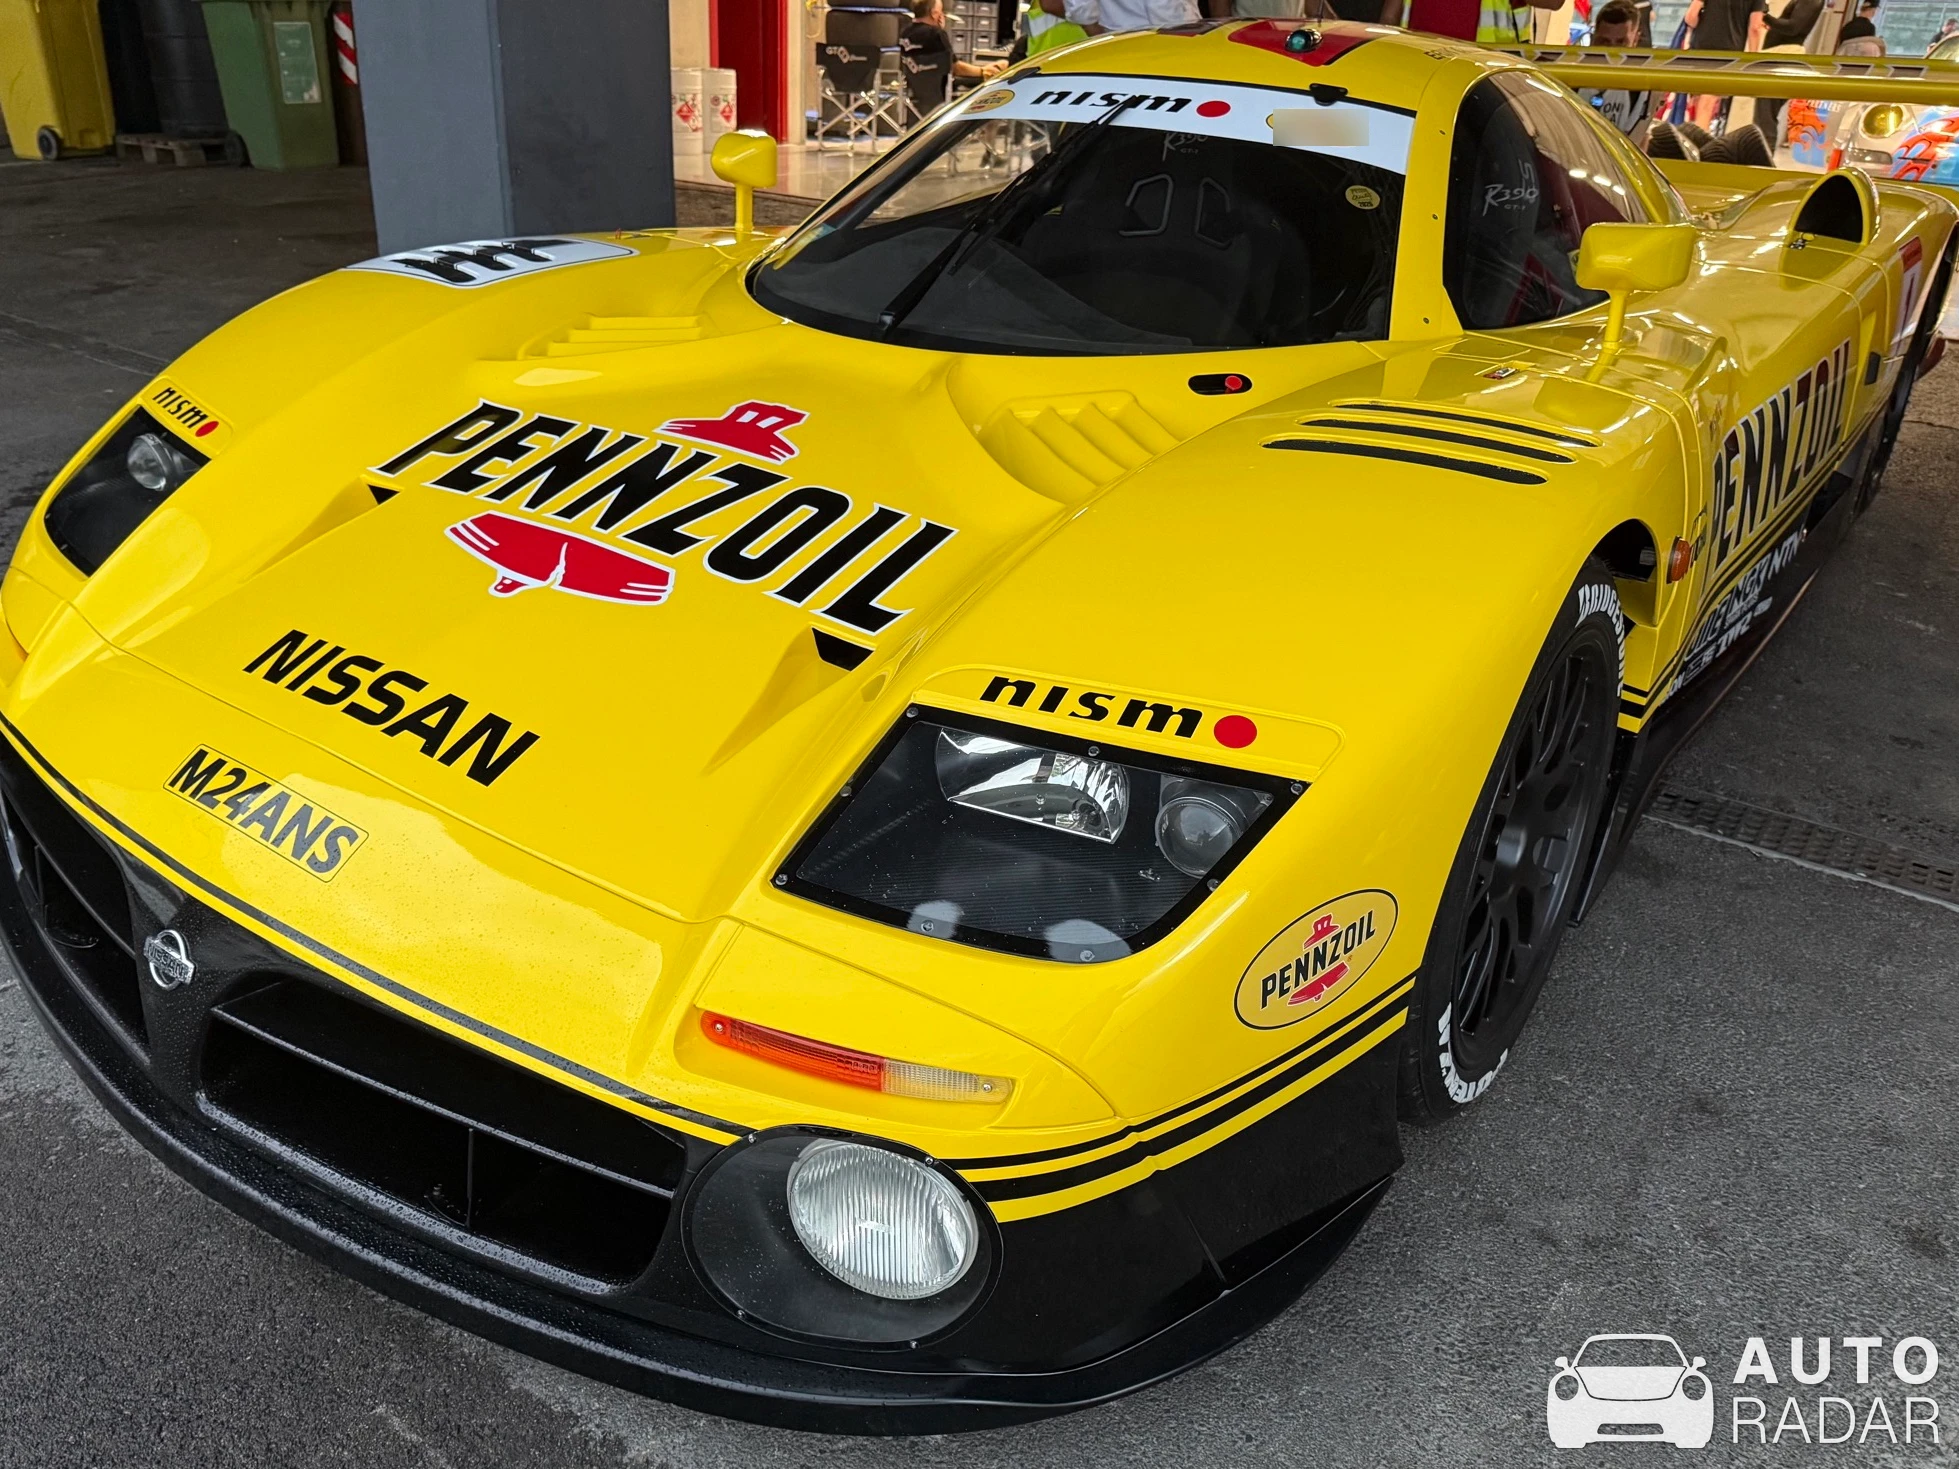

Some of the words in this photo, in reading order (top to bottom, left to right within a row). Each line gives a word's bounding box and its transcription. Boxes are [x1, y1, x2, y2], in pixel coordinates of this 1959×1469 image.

[366, 398, 960, 635] PENNZOIL
[1705, 338, 1851, 578] PENNZOIL
[242, 629, 540, 787] NISSAN
[1575, 584, 1625, 697] BRIDGESTONE
[168, 748, 359, 875] M24ANS
[1260, 910, 1377, 1009] PENNZOIL
